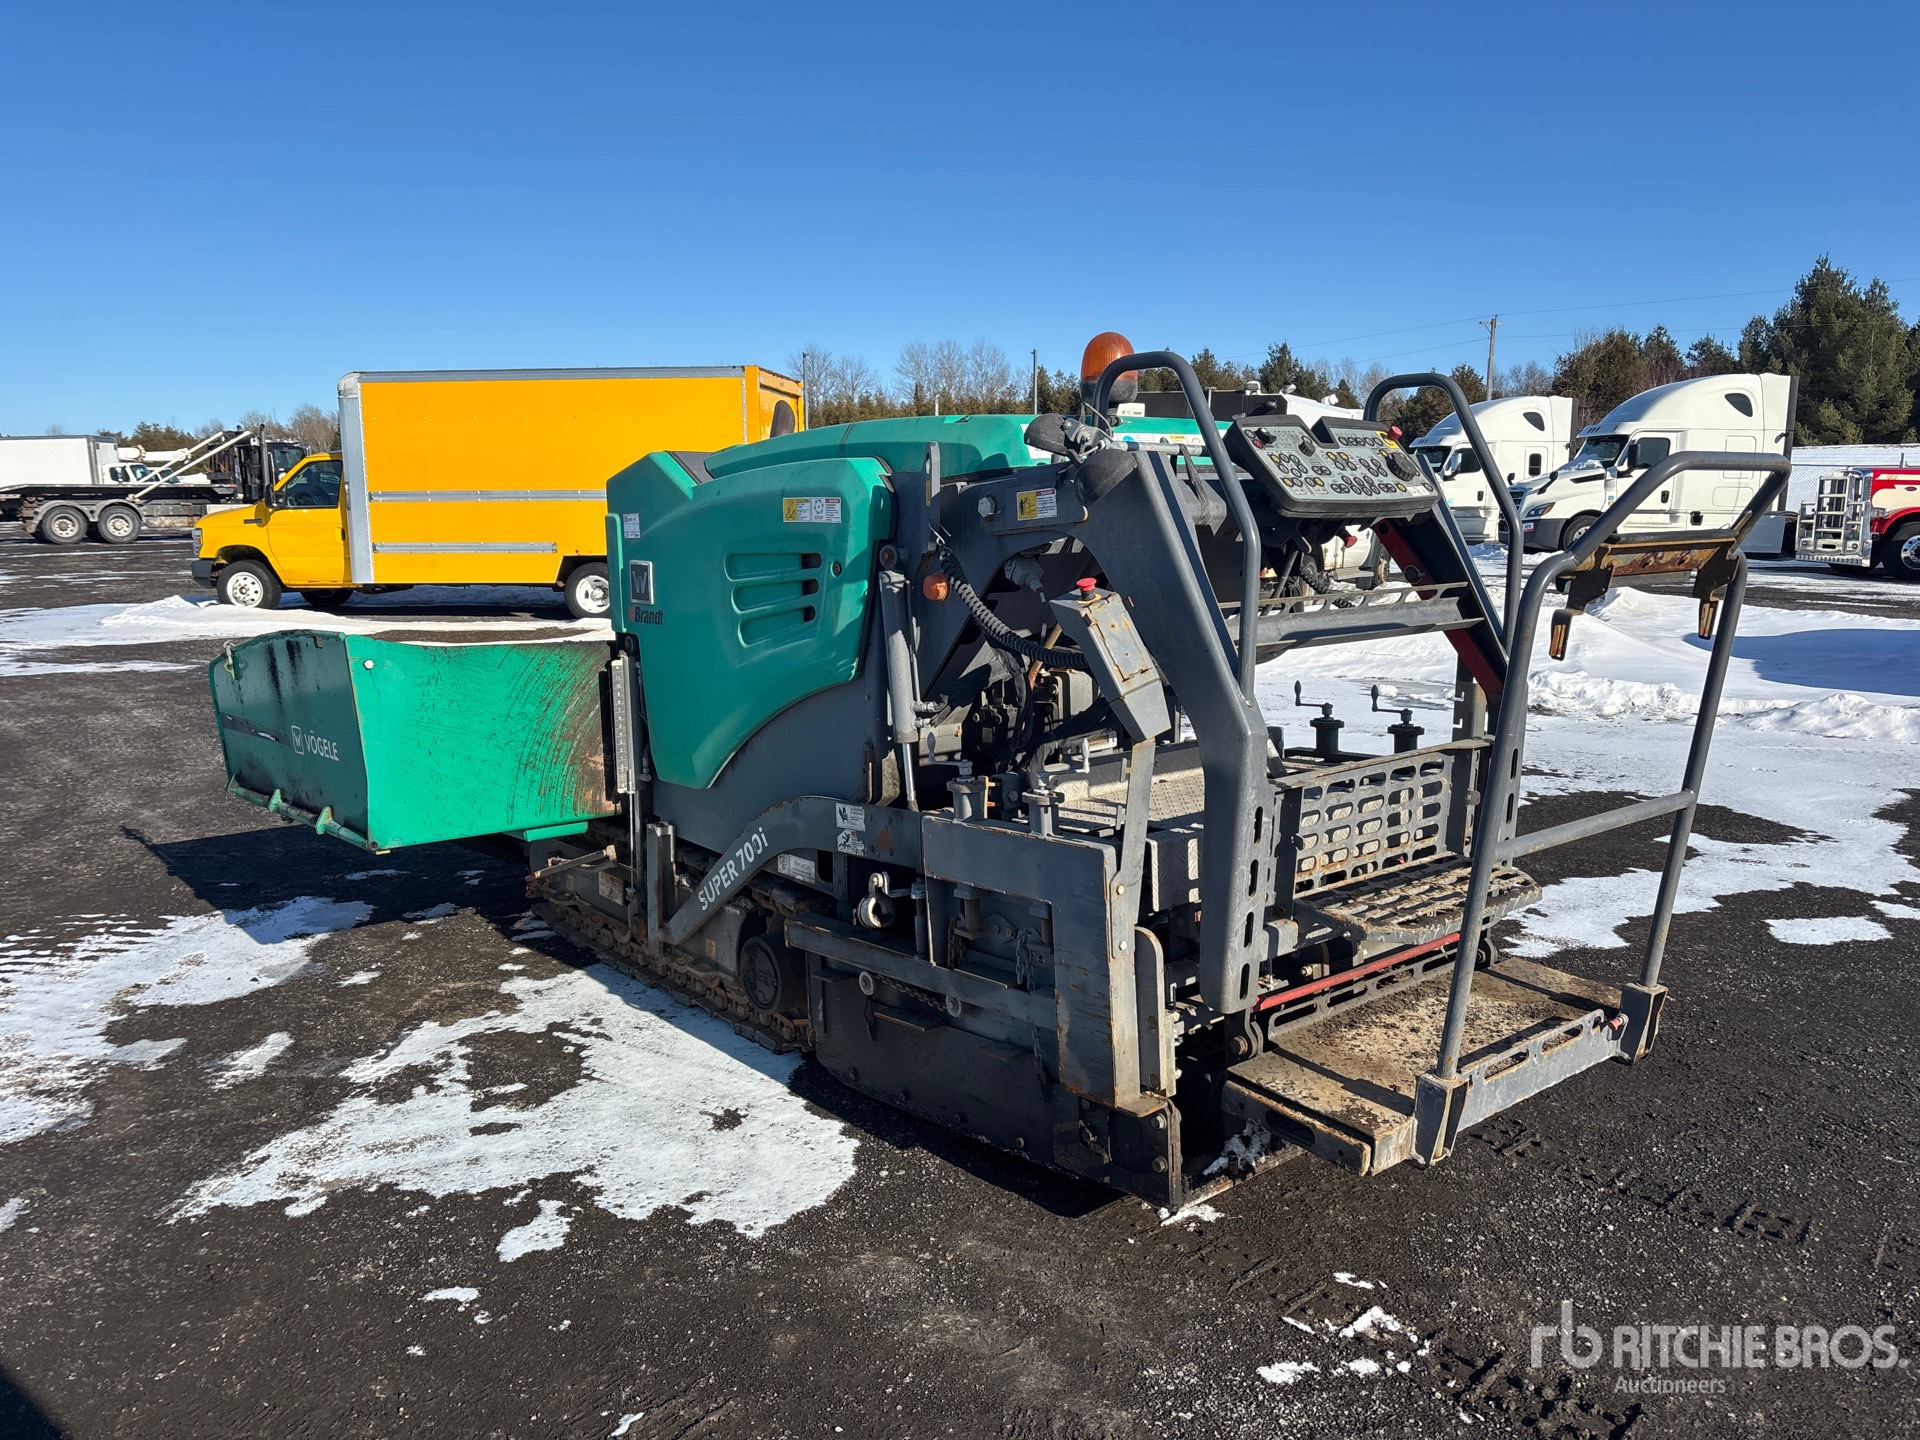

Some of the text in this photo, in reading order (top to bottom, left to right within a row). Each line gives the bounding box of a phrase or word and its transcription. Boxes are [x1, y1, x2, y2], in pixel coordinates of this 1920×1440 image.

[634, 606, 664, 625] Brandt
[304, 730, 339, 761] VÖGELE
[698, 826, 769, 911] SUPER 700i
